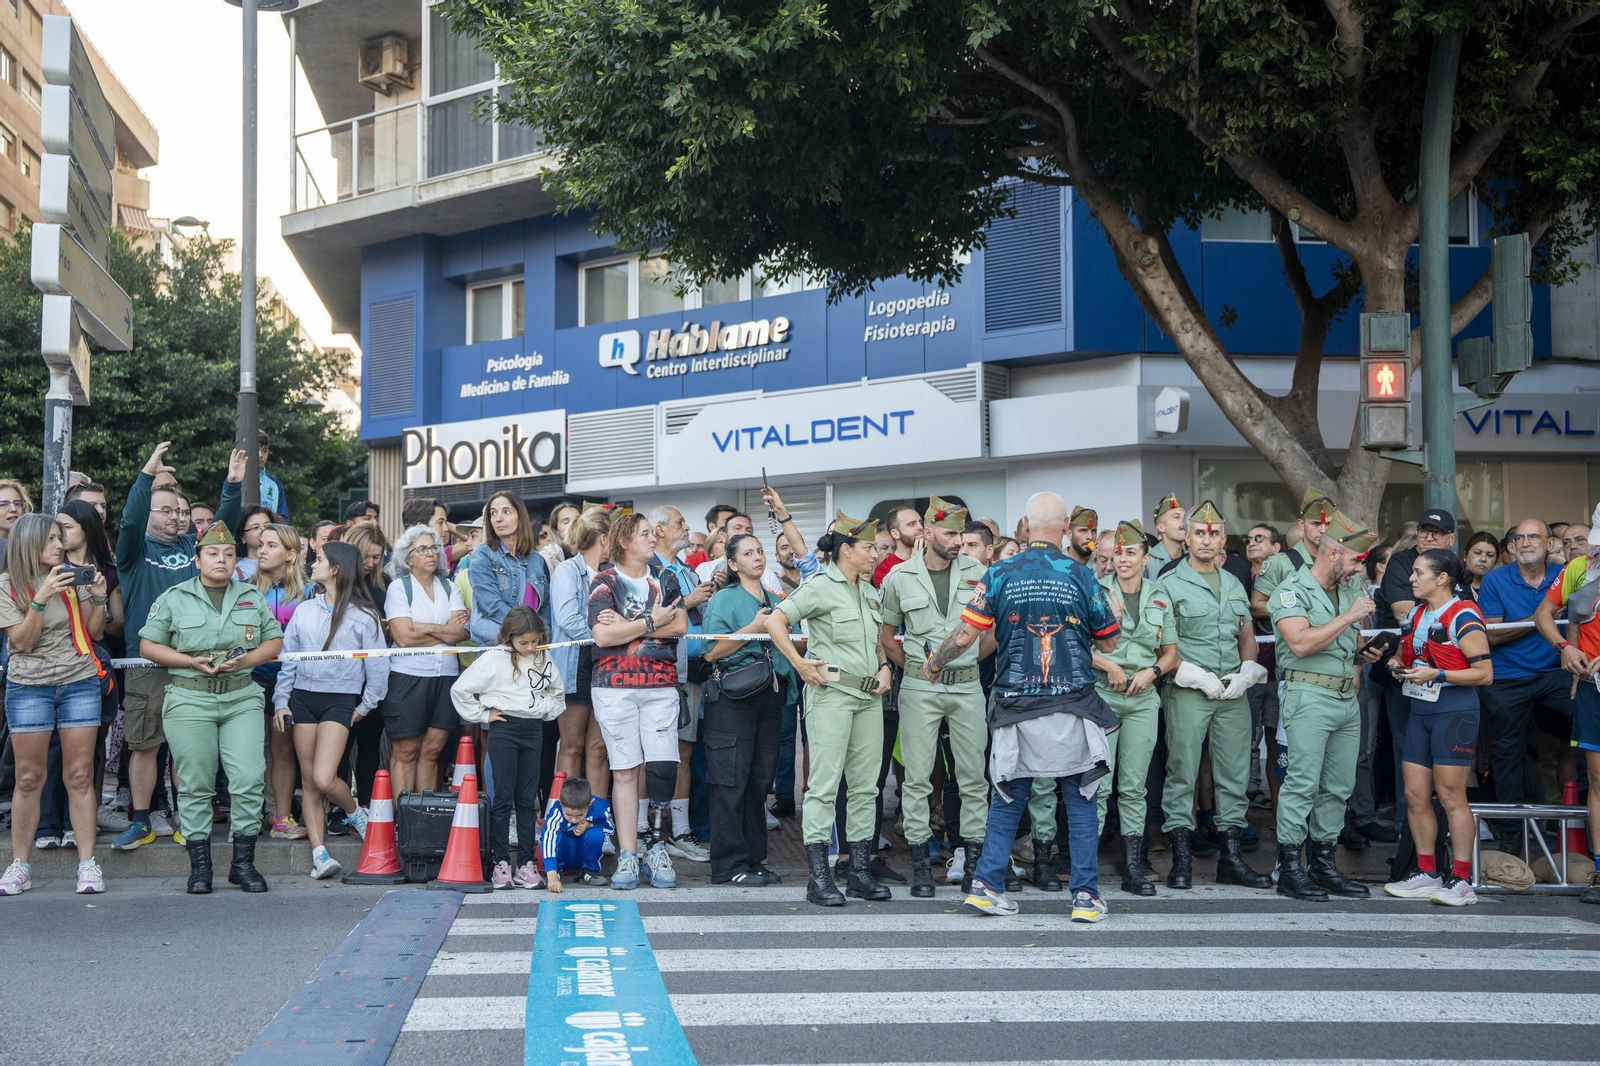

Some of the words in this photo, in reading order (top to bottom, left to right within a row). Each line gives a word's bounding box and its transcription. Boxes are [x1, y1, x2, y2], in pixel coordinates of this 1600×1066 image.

[868, 289, 950, 318] Logopedia
[645, 316, 790, 361] Háblame
[863, 315, 956, 342] Fisioterapia
[486, 351, 543, 373] Psicología
[646, 362, 687, 379] Centro
[691, 348, 789, 373] Interdisciplinar
[460, 379, 510, 398] Medicina
[511, 375, 527, 391] de
[528, 370, 570, 389] Familia
[711, 410, 915, 453] VITALDENT
[1462, 409, 1600, 435] VITAL
[402, 424, 561, 486] Phonika
[561, 912, 616, 939] cajamar
[561, 958, 627, 997] cajamar
